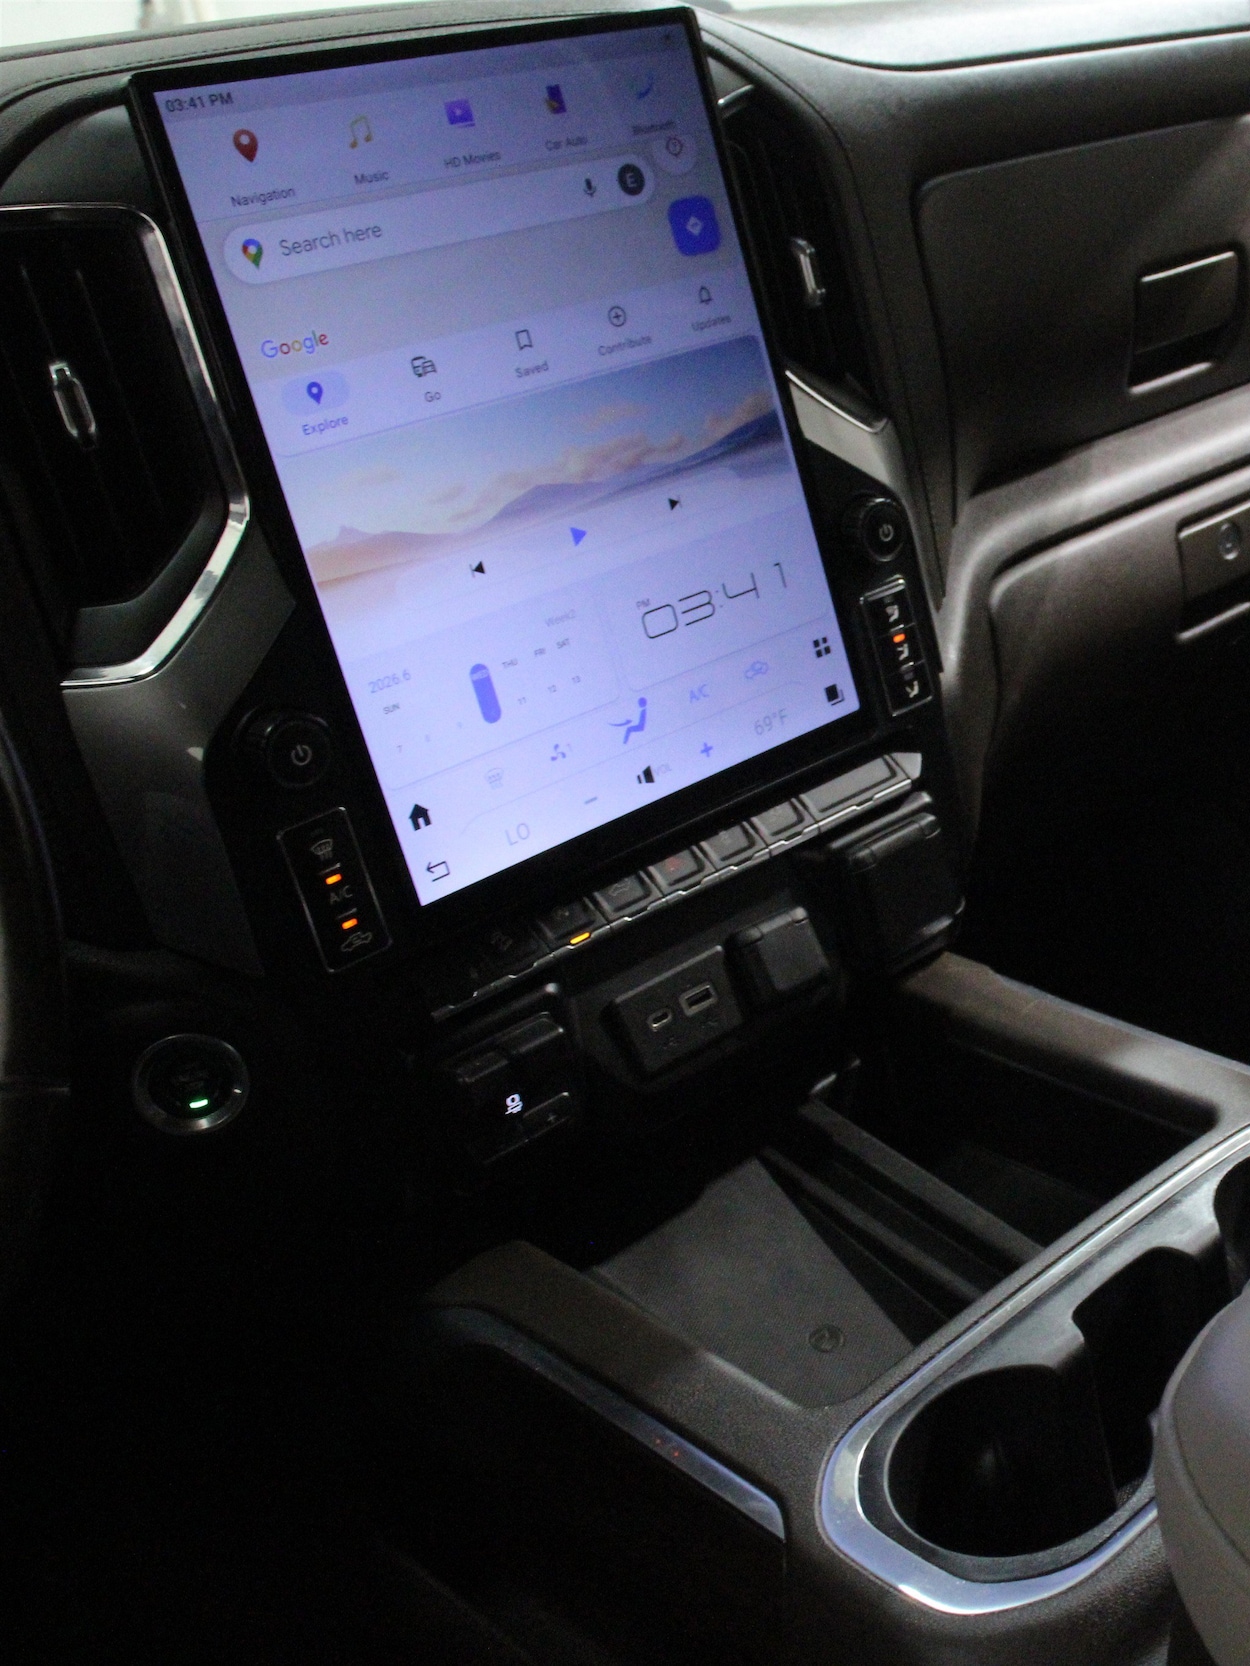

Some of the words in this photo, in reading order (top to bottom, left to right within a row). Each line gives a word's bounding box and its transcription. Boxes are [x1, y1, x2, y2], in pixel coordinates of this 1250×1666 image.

[165, 95, 206, 112] 03:41
[209, 92, 234, 108] PM
[545, 138, 564, 151] Car
[565, 136, 588, 148] Auto
[444, 155, 462, 168] HD
[463, 151, 501, 166] Movies
[353, 170, 389, 186] Music
[625, 172, 637, 187] E
[230, 186, 296, 207] Navigation
[279, 229, 342, 256] Search
[342, 223, 383, 246] here
[691, 315, 732, 332] Updates
[260, 330, 329, 358] Google
[597, 335, 652, 356] Contribute
[515, 361, 549, 378] Saved
[424, 390, 442, 403] Go
[302, 414, 349, 436] Explore
[368, 668, 411, 694] 2026.6
[382, 702, 400, 714] SUN
[556, 638, 570, 649] SAT
[689, 684, 710, 703] A/C
[754, 708, 788, 736] 69°F
[505, 822, 531, 846] LO
[329, 885, 353, 906] A/C
